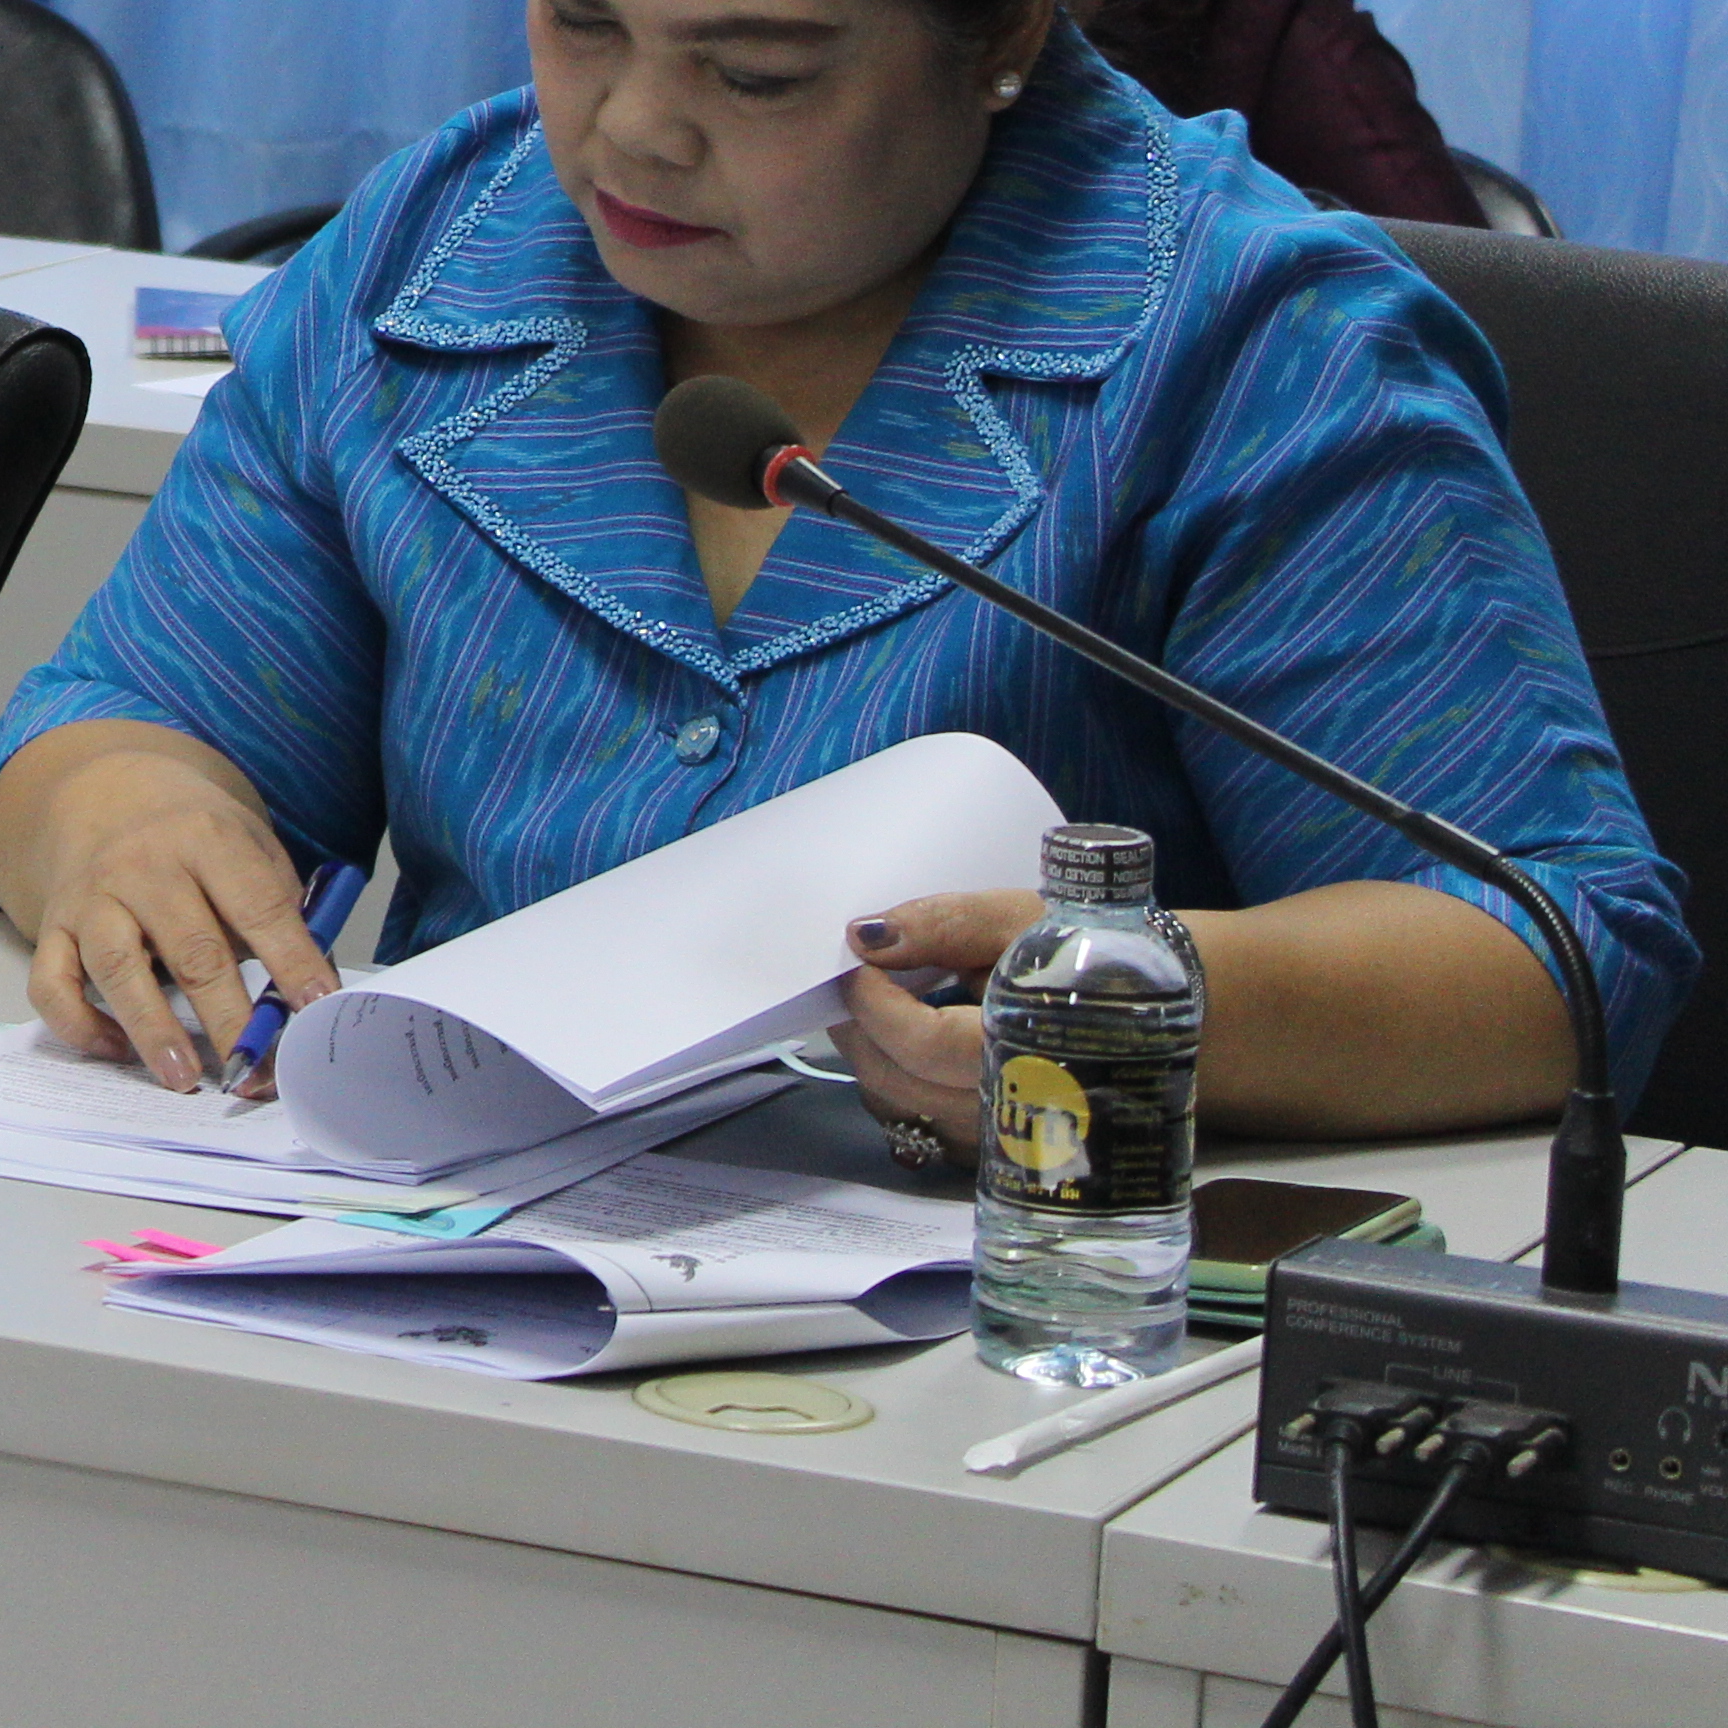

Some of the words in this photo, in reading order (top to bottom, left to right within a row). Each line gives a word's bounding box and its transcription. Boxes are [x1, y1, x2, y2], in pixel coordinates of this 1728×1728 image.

[1286, 1297, 1405, 1329] PROFESSIONAL
[1285, 1314, 1393, 1343] CONFERENCE
[1396, 1330, 1463, 1355] SYSTEM
[1433, 1365, 1473, 1385] LINE
